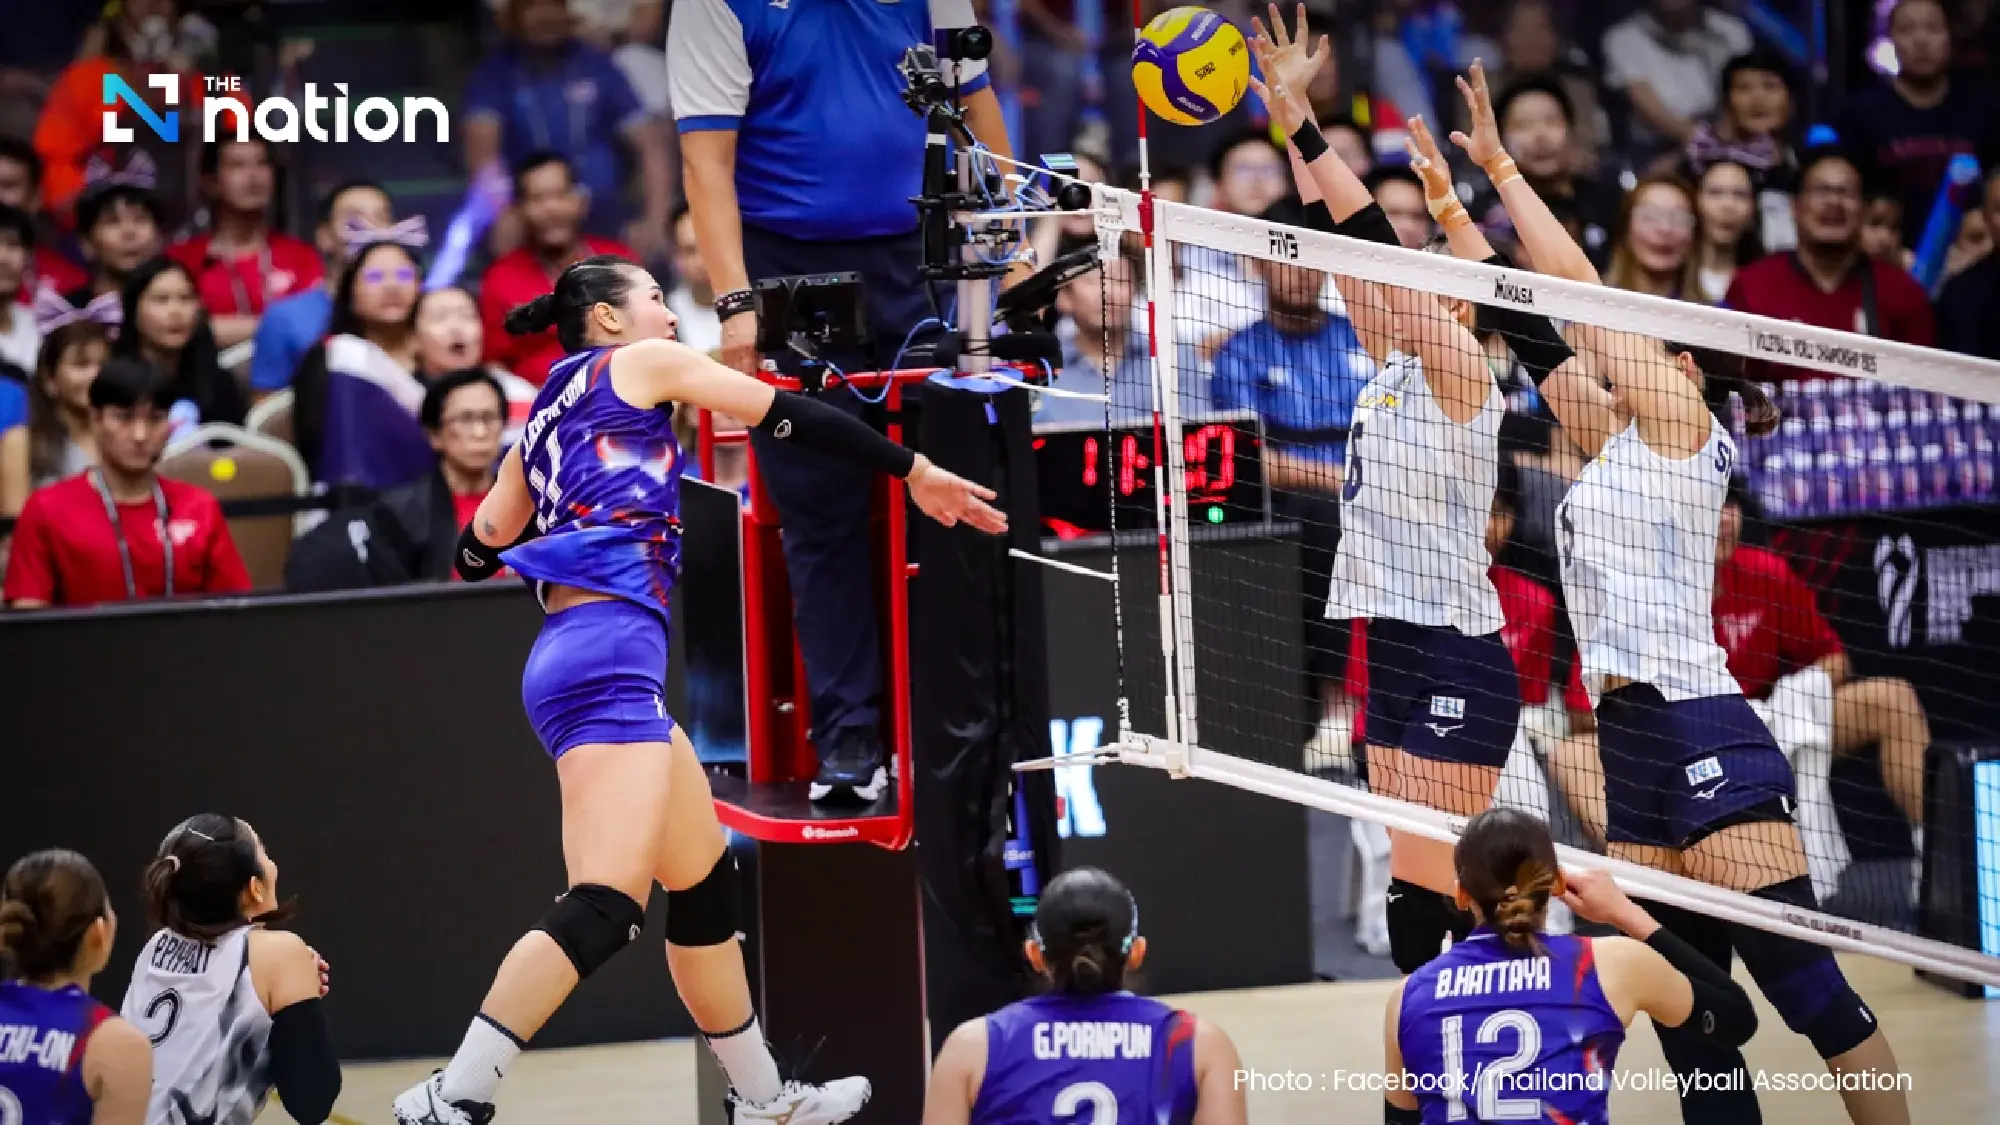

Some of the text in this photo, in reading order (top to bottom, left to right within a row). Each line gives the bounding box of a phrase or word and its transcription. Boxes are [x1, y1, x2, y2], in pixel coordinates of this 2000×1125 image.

[1494, 274, 1534, 306] MIKASA
[1435, 956, 1552, 1000] B.HATTAYA
[1033, 1021, 1152, 1060] G.PORNPUN
[1441, 1009, 1543, 1123] 12
